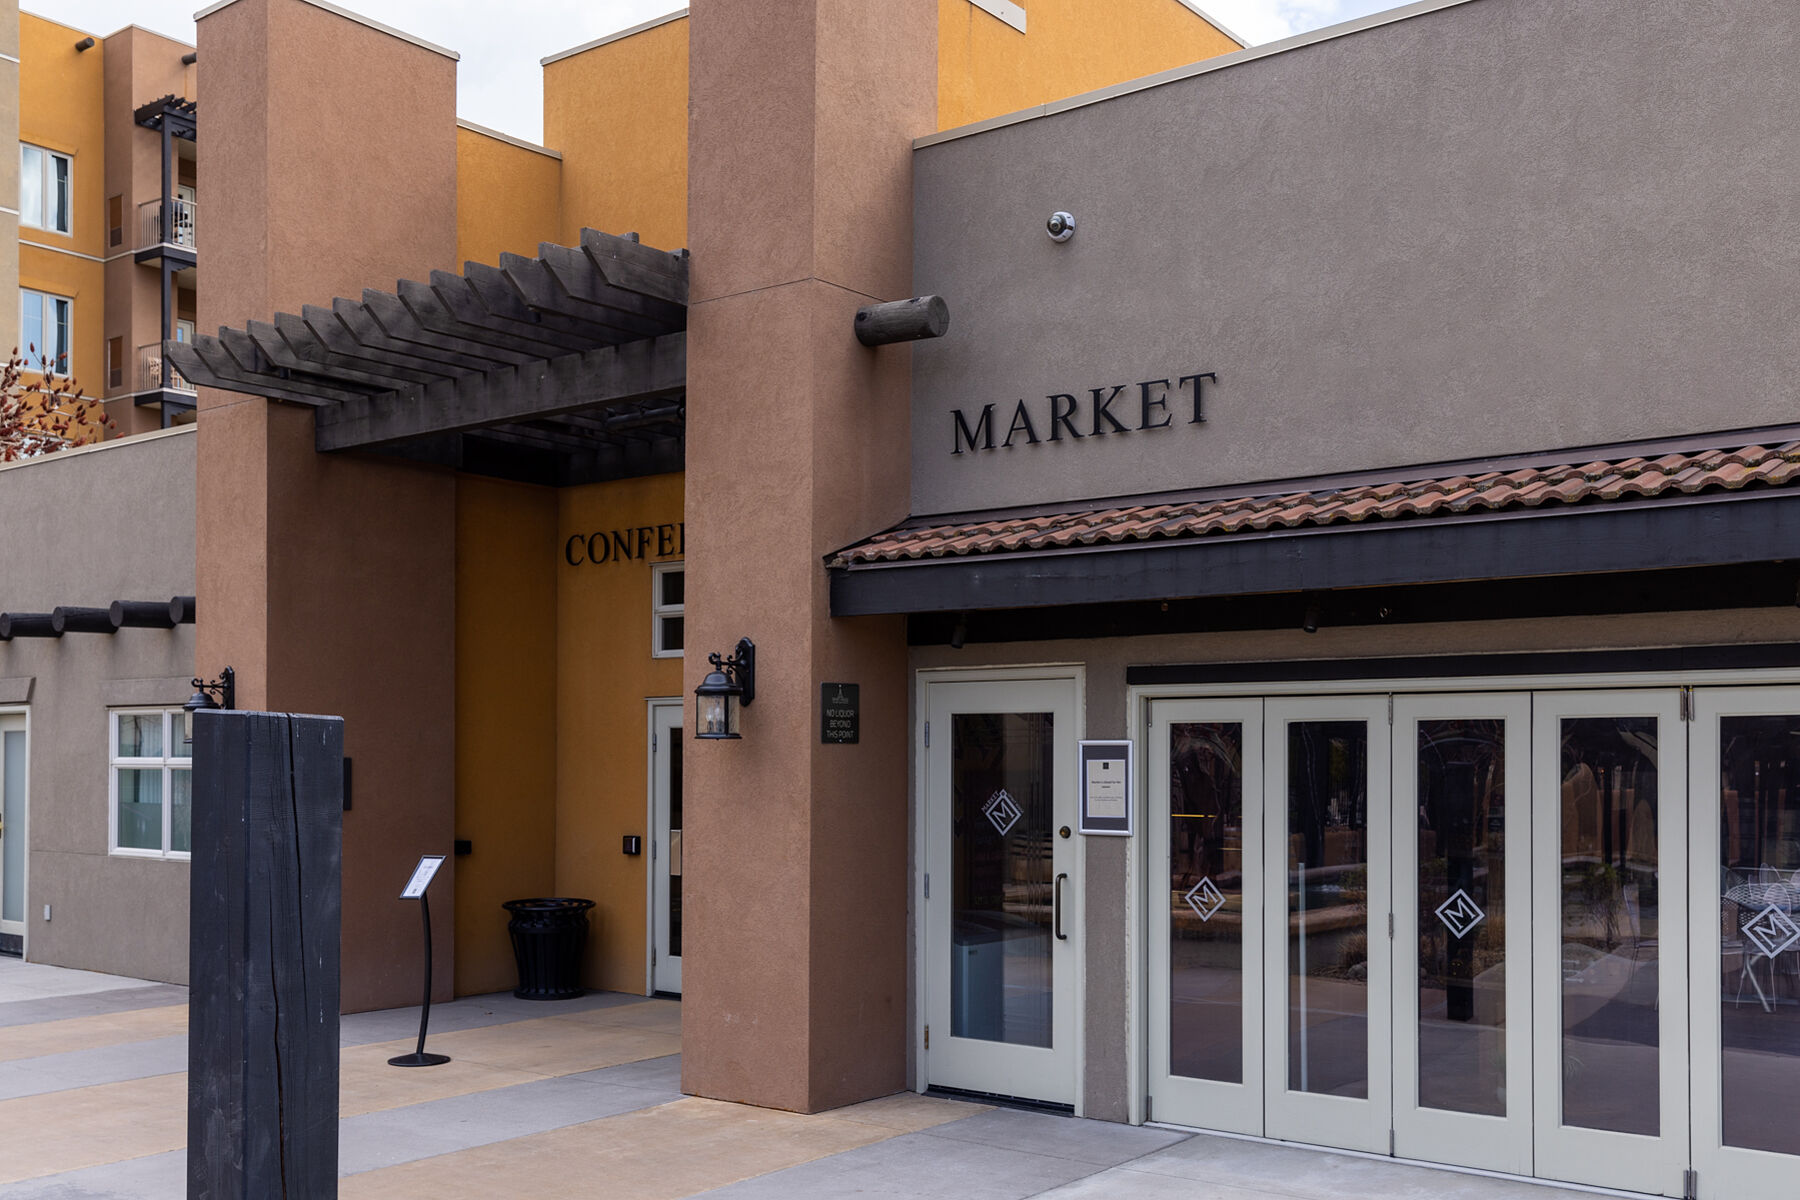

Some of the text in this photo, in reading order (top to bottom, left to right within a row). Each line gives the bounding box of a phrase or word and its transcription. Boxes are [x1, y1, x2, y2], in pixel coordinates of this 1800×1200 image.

[950, 372, 1216, 454] MARKET
[826, 709, 855, 718] NO LIQUOR
[829, 719, 851, 728] BEYOND
[826, 730, 854, 739] THIS POINT
[992, 800, 1015, 829] M
[1192, 884, 1218, 913] M
[1445, 898, 1476, 930] M
[1752, 914, 1792, 950] M
